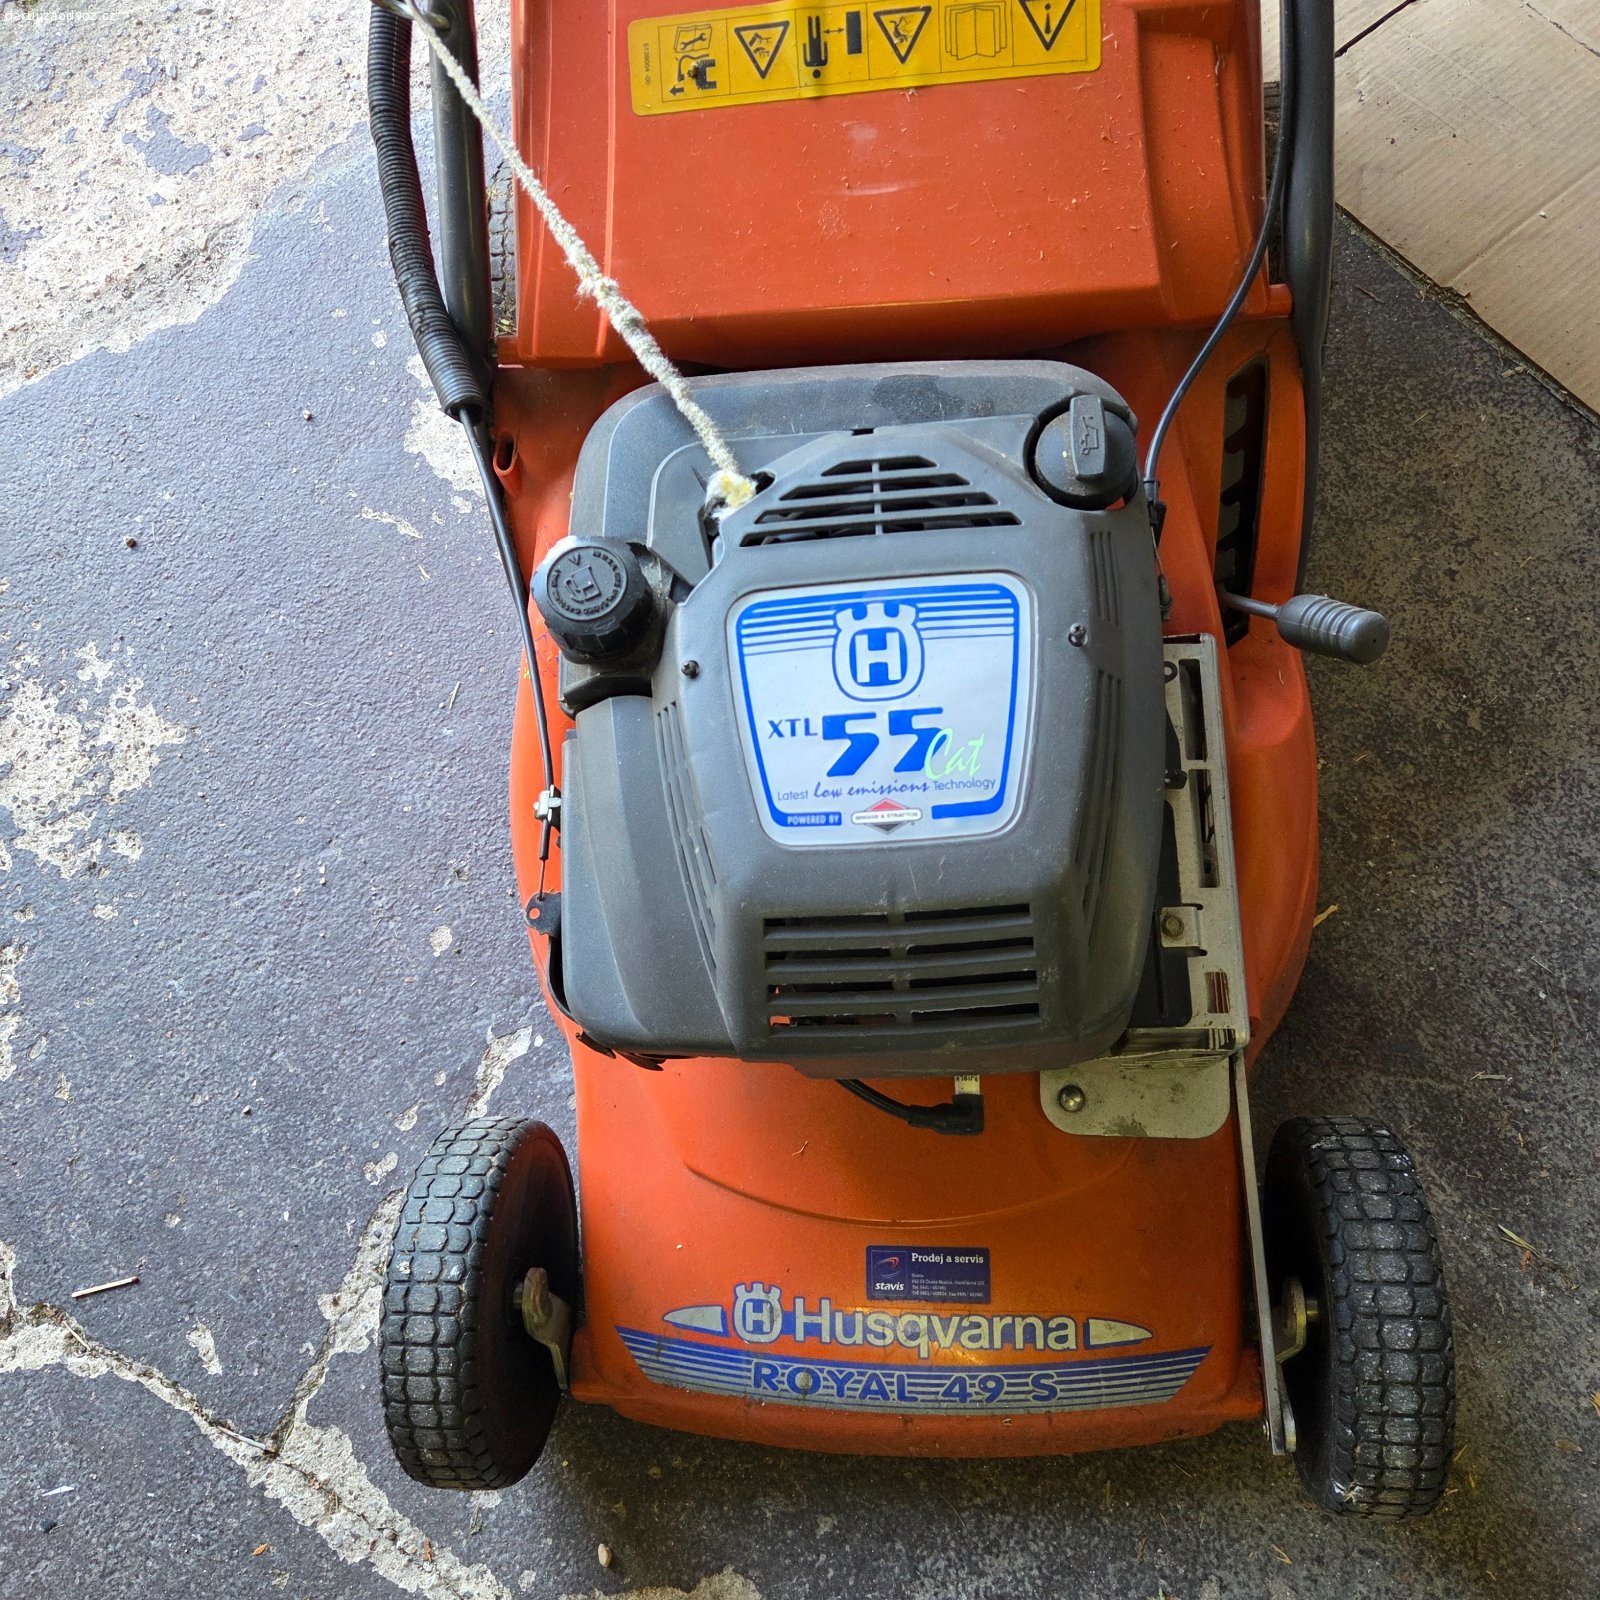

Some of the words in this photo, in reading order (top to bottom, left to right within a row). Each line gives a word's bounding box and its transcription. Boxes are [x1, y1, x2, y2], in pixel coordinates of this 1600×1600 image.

[767, 717, 818, 739] XTL
[822, 706, 945, 778] 55
[924, 727, 984, 780] Cat
[777, 789, 809, 801] Latest
[813, 781, 844, 799] low
[847, 779, 930, 797] emissions
[933, 778, 997, 792] Technology
[787, 814, 826, 826] POWERED
[828, 814, 840, 825] BY
[911, 1252, 944, 1265] Prodej
[945, 1255, 952, 1263] a
[954, 1254, 984, 1264] servis
[875, 1282, 905, 1291] stavis
[795, 1297, 1078, 1359] Husqvarna
[753, 1361, 919, 1402] ROYAL
[941, 1374, 1006, 1403] 49
[1031, 1372, 1059, 1402] S
